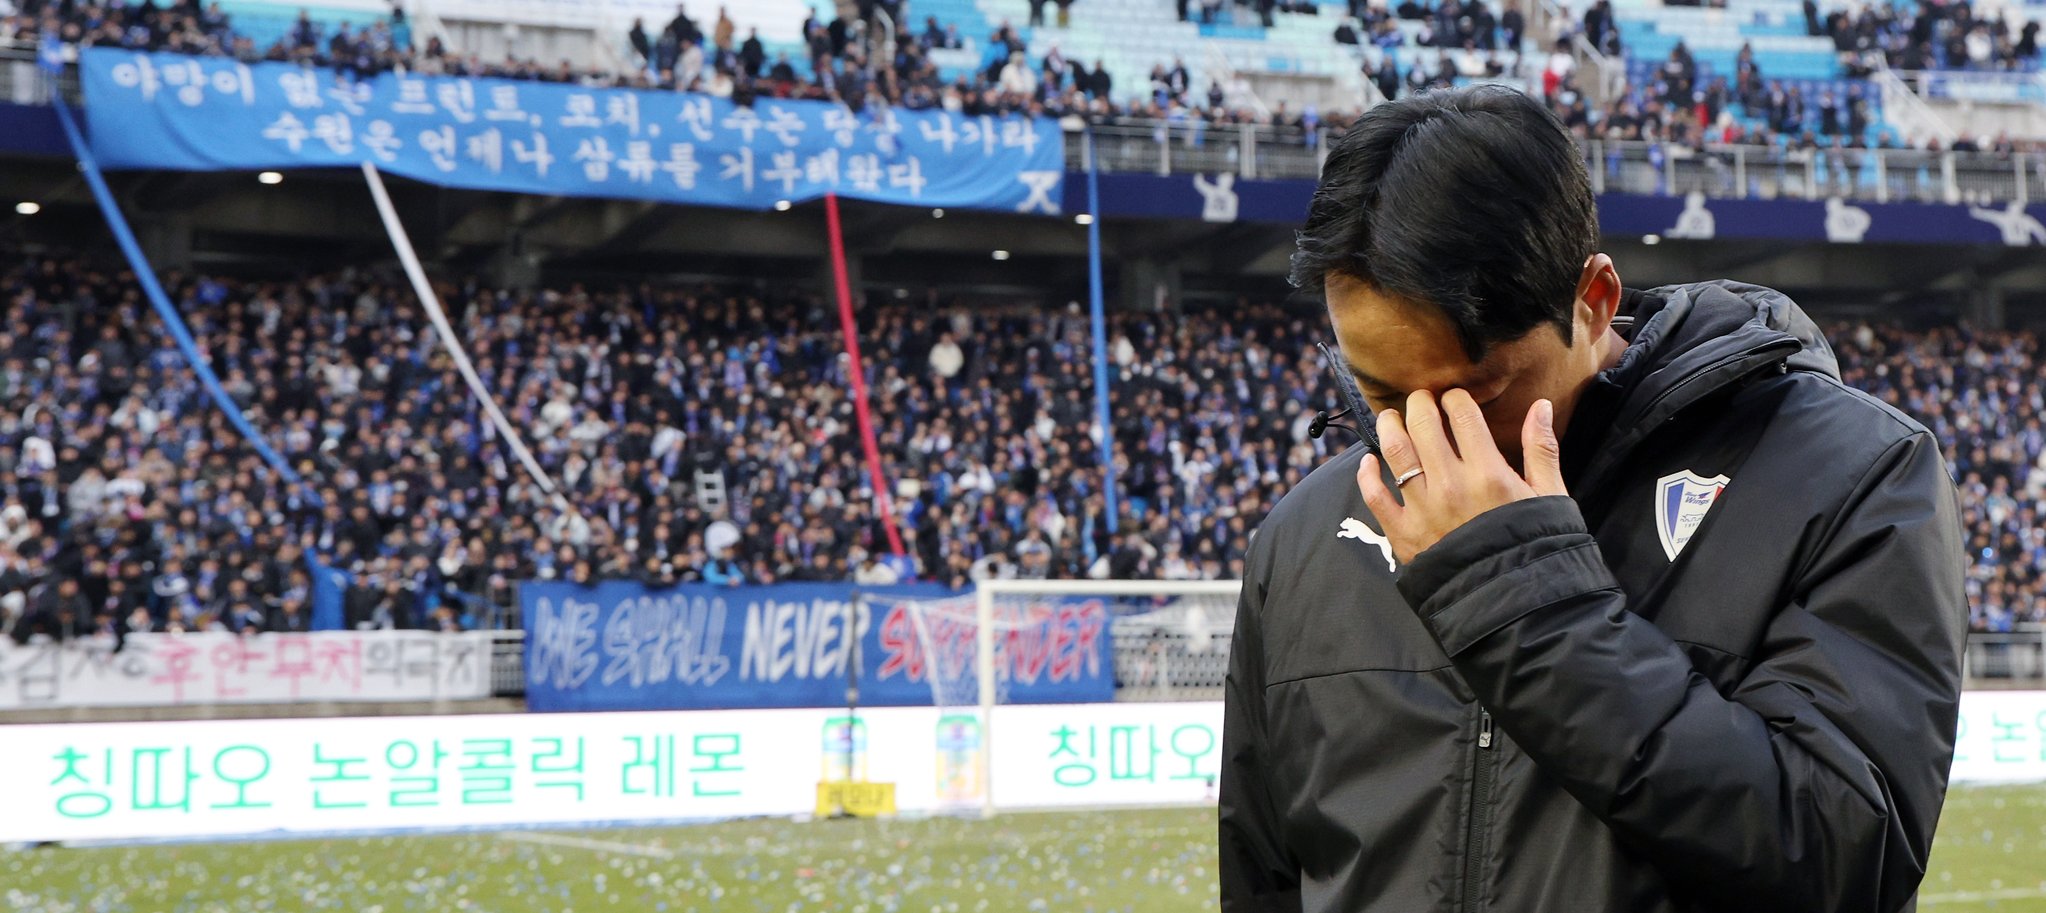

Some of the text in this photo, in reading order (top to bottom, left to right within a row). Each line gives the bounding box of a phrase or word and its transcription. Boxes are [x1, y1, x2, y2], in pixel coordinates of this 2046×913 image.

[112, 54, 255, 107] 야망이
[677, 97, 806, 148] 선수는
[918, 112, 1041, 156] 나가라
[261, 111, 402, 163] 수원은
[417, 124, 554, 177] 언제나
[572, 135, 703, 191] 삼류를
[529, 596, 599, 690] WE
[738, 597, 871, 684] NEVER
[51, 732, 745, 819] 칭따오 논알콜릭 레몬
[1050, 723, 1217, 787] 칭따오
[1992, 708, 2046, 763] 논
